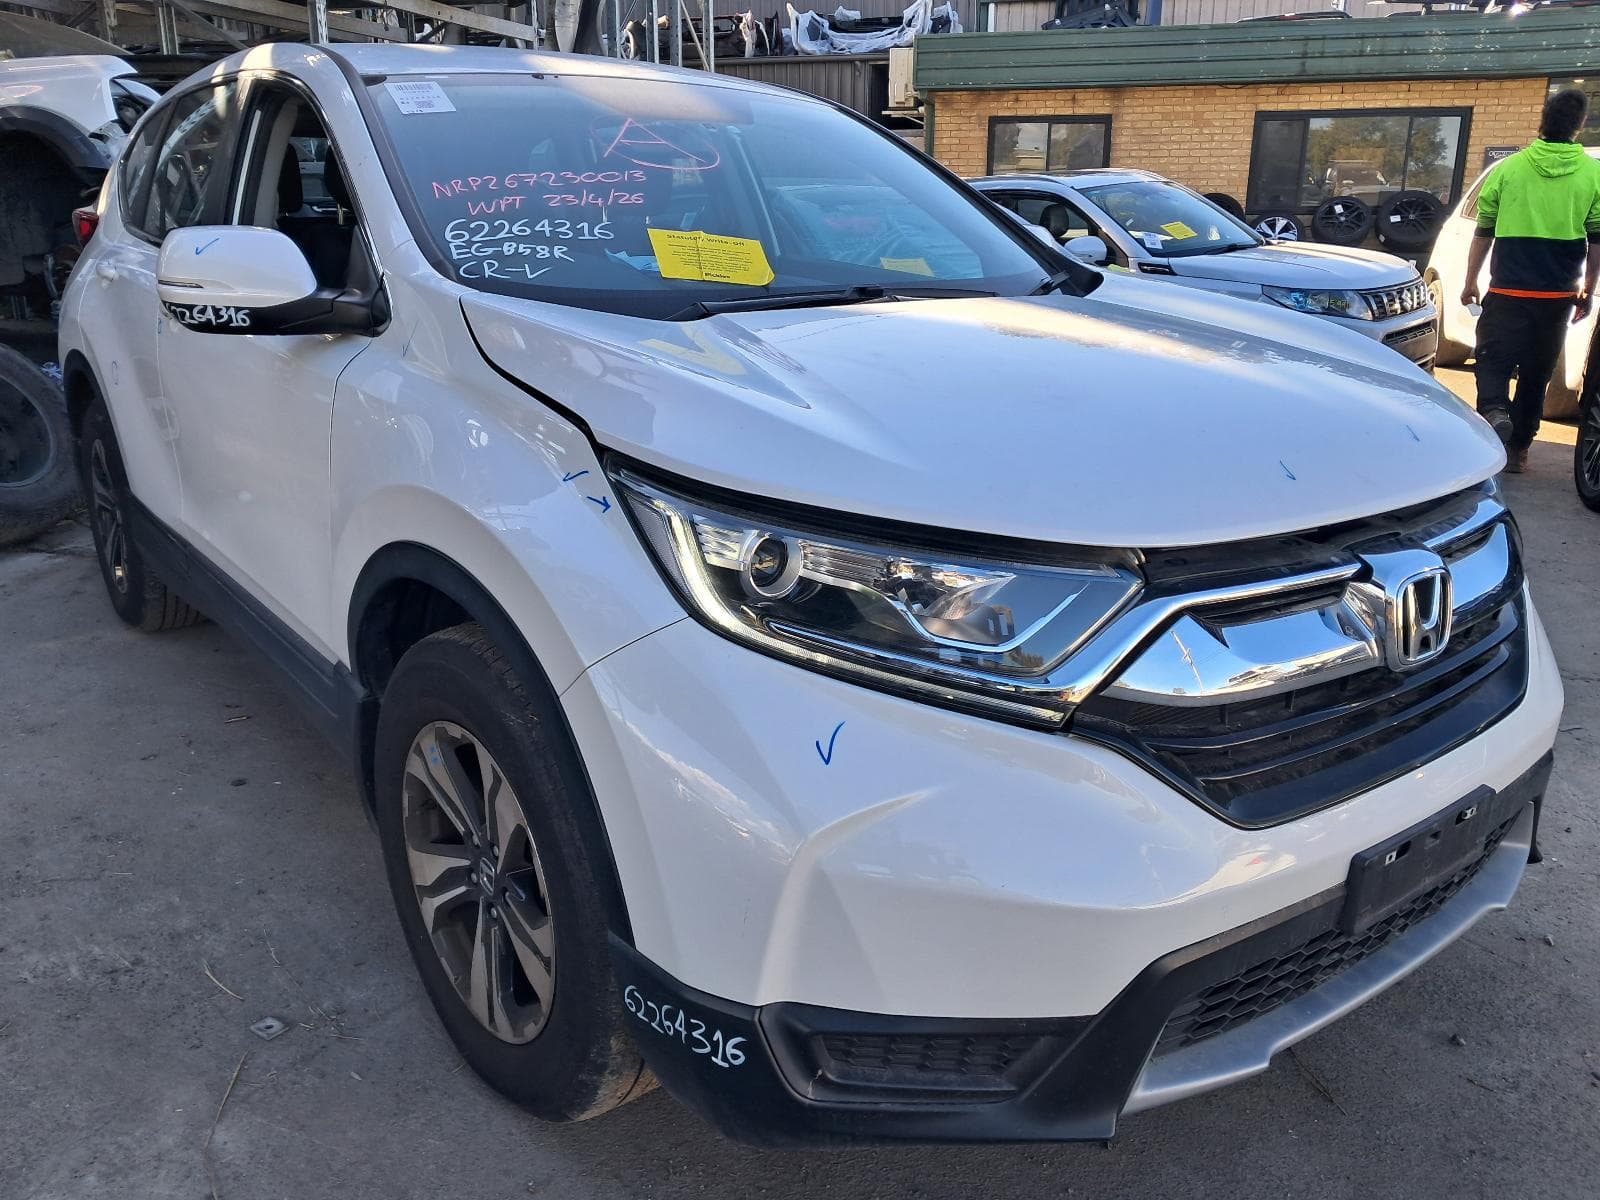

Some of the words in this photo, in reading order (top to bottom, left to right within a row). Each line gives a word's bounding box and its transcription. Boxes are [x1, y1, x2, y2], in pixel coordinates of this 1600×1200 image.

[604, 117, 706, 163] A
[467, 196, 528, 216] WPT
[542, 189, 645, 208] 23/4/26
[444, 218, 615, 243] 62264316
[459, 259, 552, 280] CR-V
[624, 985, 748, 1068] 62264316
